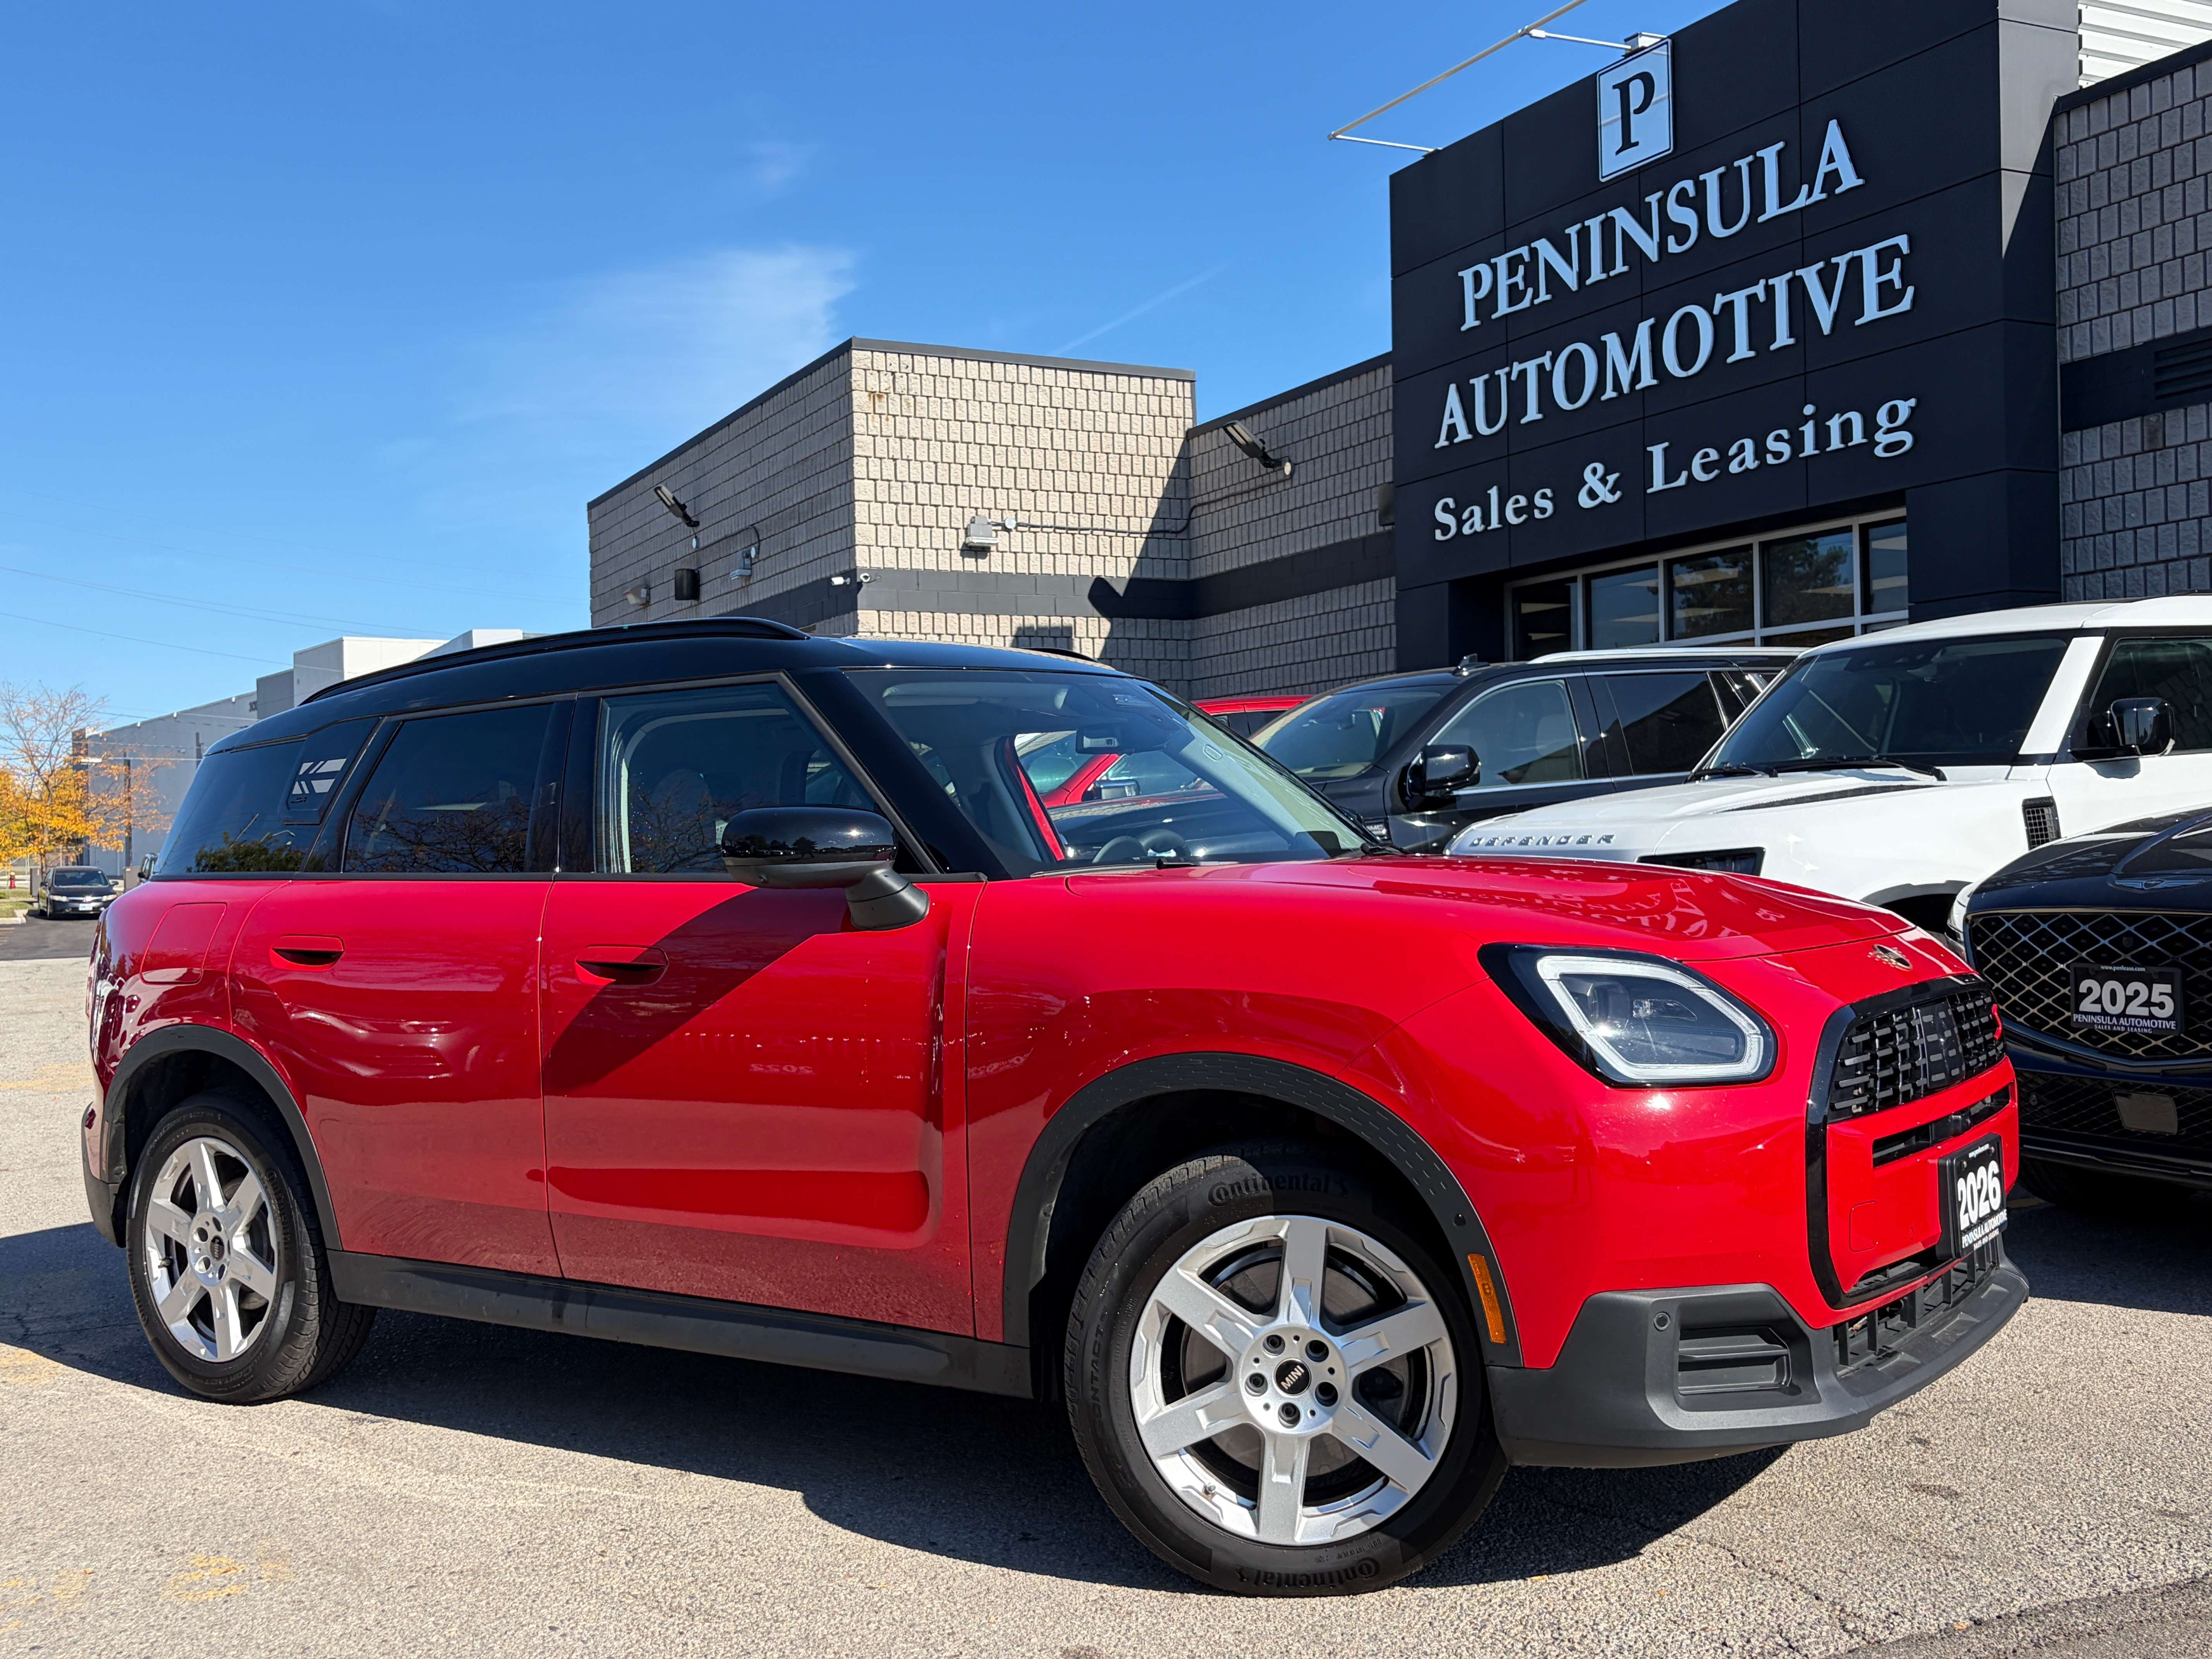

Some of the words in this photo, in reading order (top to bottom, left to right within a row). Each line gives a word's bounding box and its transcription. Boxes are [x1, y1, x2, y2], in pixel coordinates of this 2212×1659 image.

[1613, 71, 1655, 156] P
[1458, 119, 1865, 331] PENINSULA
[1434, 234, 1915, 449] AUTOMOTIVE
[1434, 485, 1554, 541] Sales
[1578, 462, 1622, 510] &
[1647, 397, 1917, 493] Leasing
[1468, 834, 1616, 847] DEFENDER
[2079, 979, 2174, 1018] 2025
[2073, 1013, 2117, 1025] PENINSULA
[2119, 1018, 2176, 1029] AUTOMOTIVE
[1208, 1172, 1330, 1207] Continental
[1957, 1160, 2001, 1230] 2026
[1962, 1224, 1984, 1249] PENINSULA
[1281, 1365, 1305, 1389] MINI
[1254, 1557, 1381, 1588] Continental
